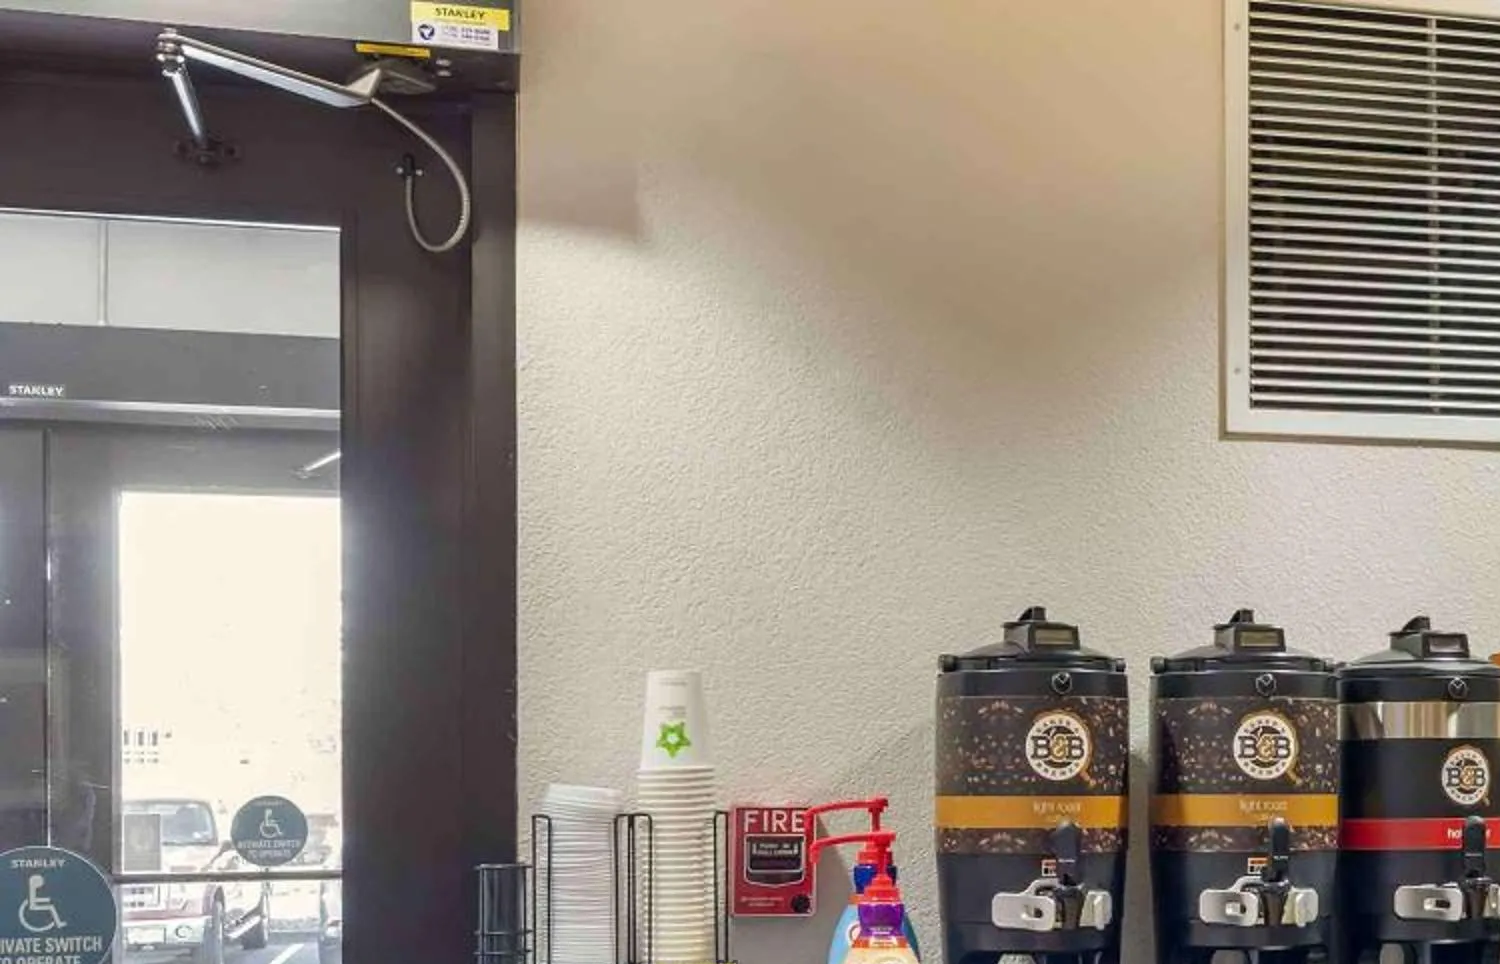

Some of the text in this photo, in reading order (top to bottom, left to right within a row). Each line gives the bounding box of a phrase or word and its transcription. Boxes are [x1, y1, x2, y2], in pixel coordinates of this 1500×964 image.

[435, 8, 485, 20] STANLEY
[9, 384, 65, 397] STANLEY
[744, 809, 806, 833] FIRE
[10, 859, 65, 868] STANLEY
[45, 936, 102, 953] SWITCH
